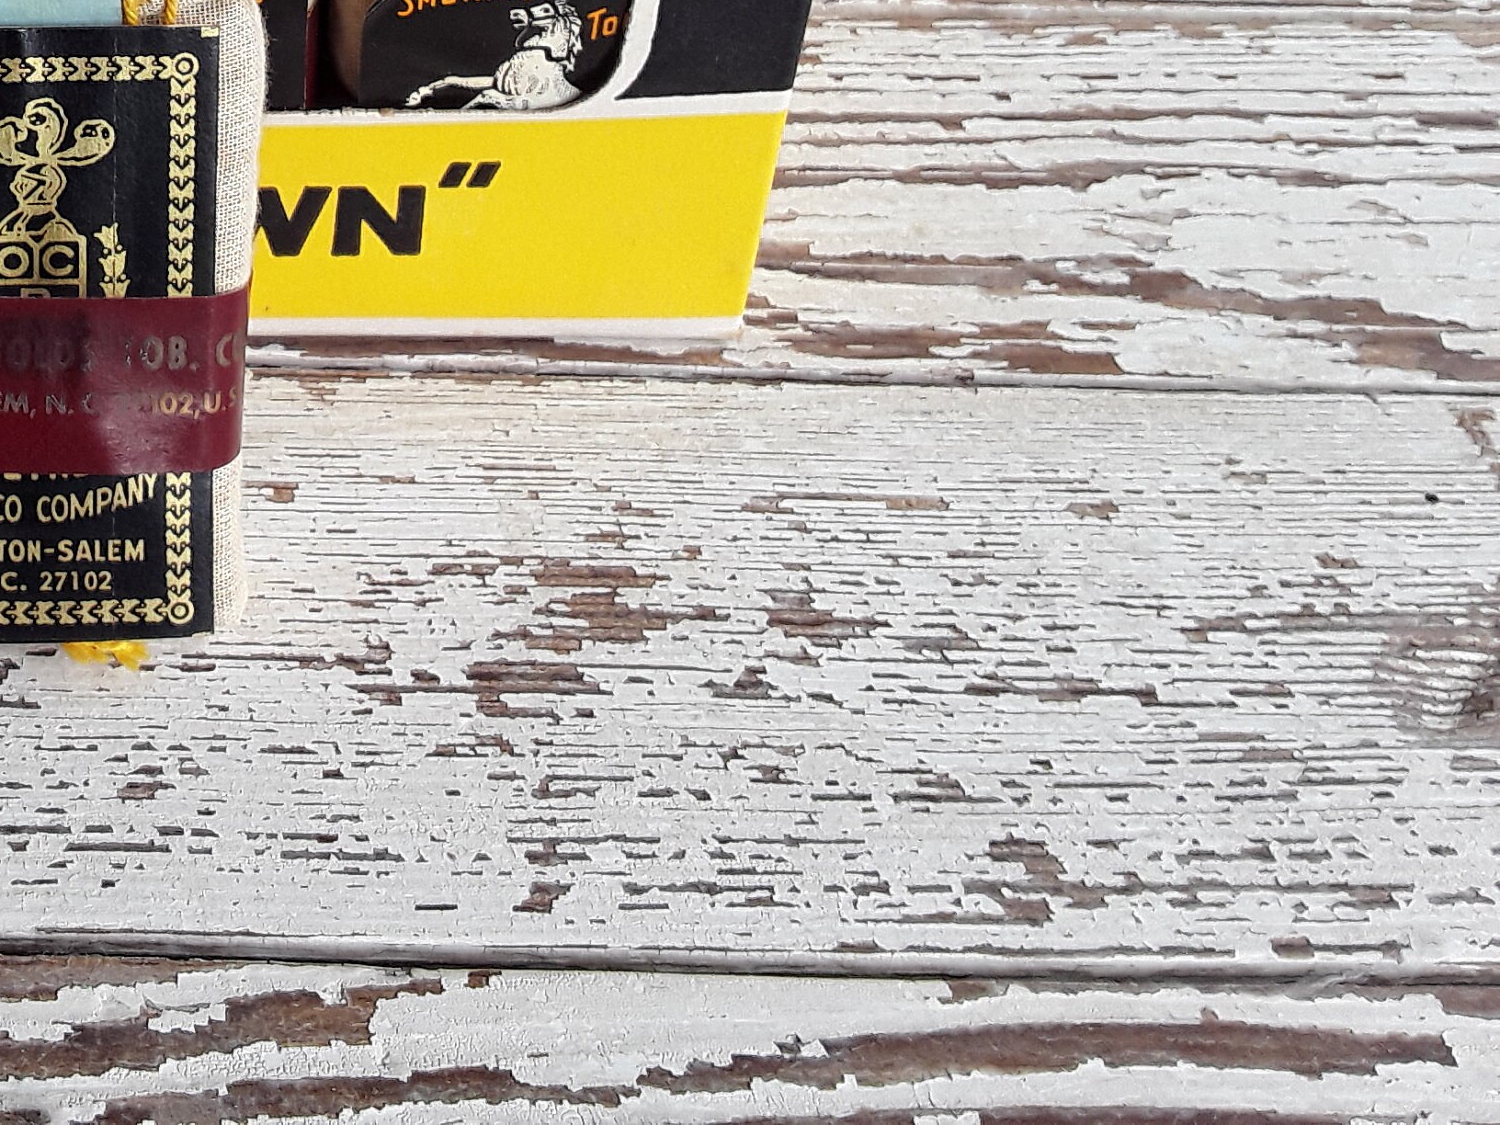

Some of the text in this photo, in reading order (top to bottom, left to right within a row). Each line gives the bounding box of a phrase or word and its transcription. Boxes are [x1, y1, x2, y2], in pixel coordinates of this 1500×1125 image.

[36, 473, 158, 524] COMPANY
[0, 572, 29, 592] C.
[39, 571, 113, 592] 27102
